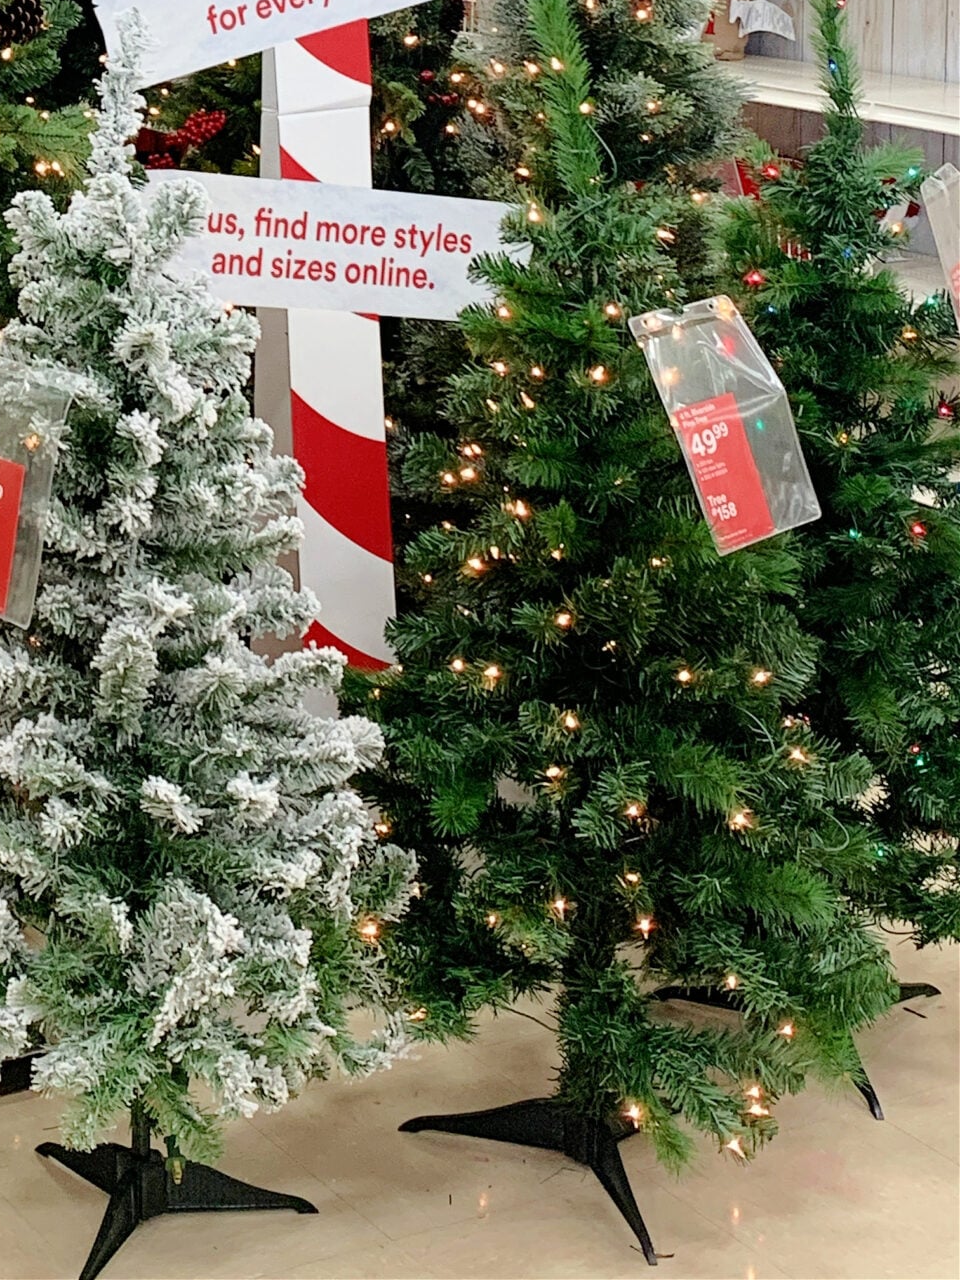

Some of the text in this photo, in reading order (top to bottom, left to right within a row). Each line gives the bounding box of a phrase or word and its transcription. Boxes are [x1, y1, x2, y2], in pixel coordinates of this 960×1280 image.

[206, 4, 248, 35] for
[200, 207, 473, 258] us, find more styles
[211, 247, 435, 290] and sizes online.
[707, 494, 727, 508] Tree
